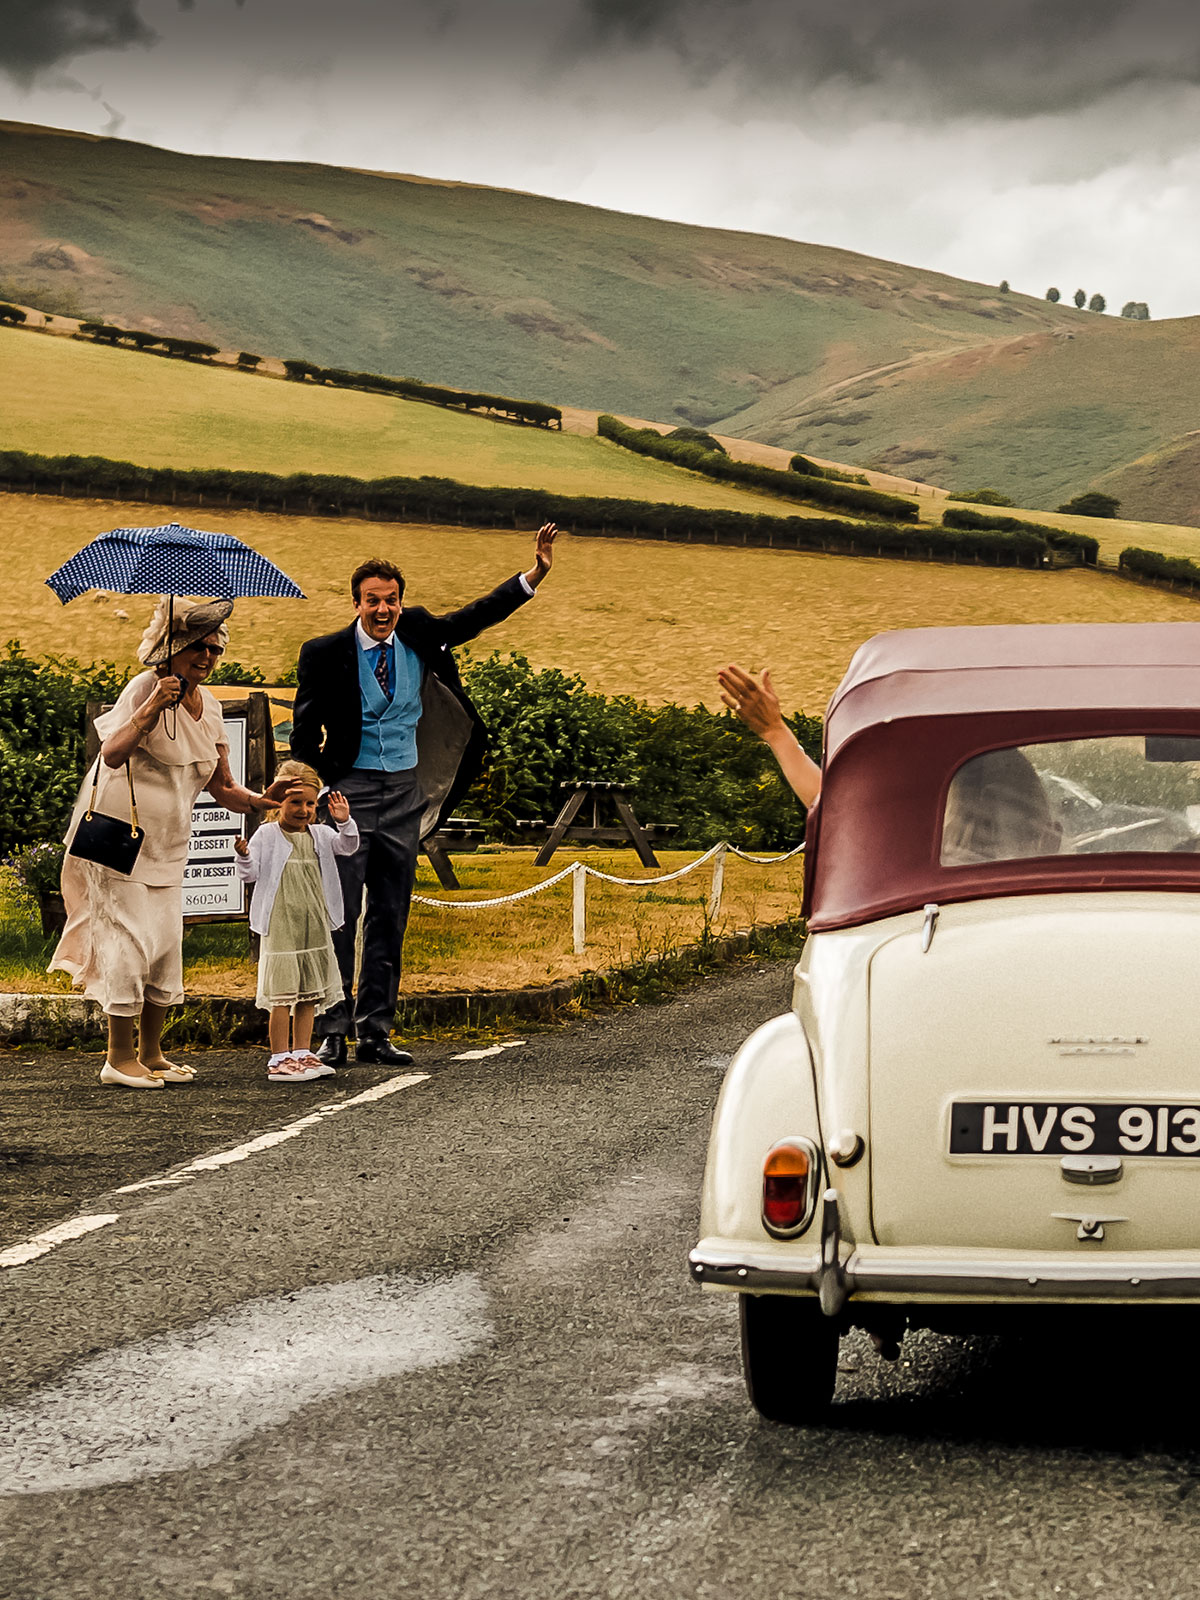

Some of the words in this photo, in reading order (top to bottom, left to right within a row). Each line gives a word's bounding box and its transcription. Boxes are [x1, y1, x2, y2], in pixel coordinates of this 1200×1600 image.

[191, 813, 201, 822] OF
[203, 812, 230, 822] COBRA
[194, 839, 230, 850] DESSERT
[191, 868, 201, 878] OR
[203, 866, 236, 877] DESSERT
[186, 893, 228, 905] 860204
[982, 1105, 1096, 1151] HVS
